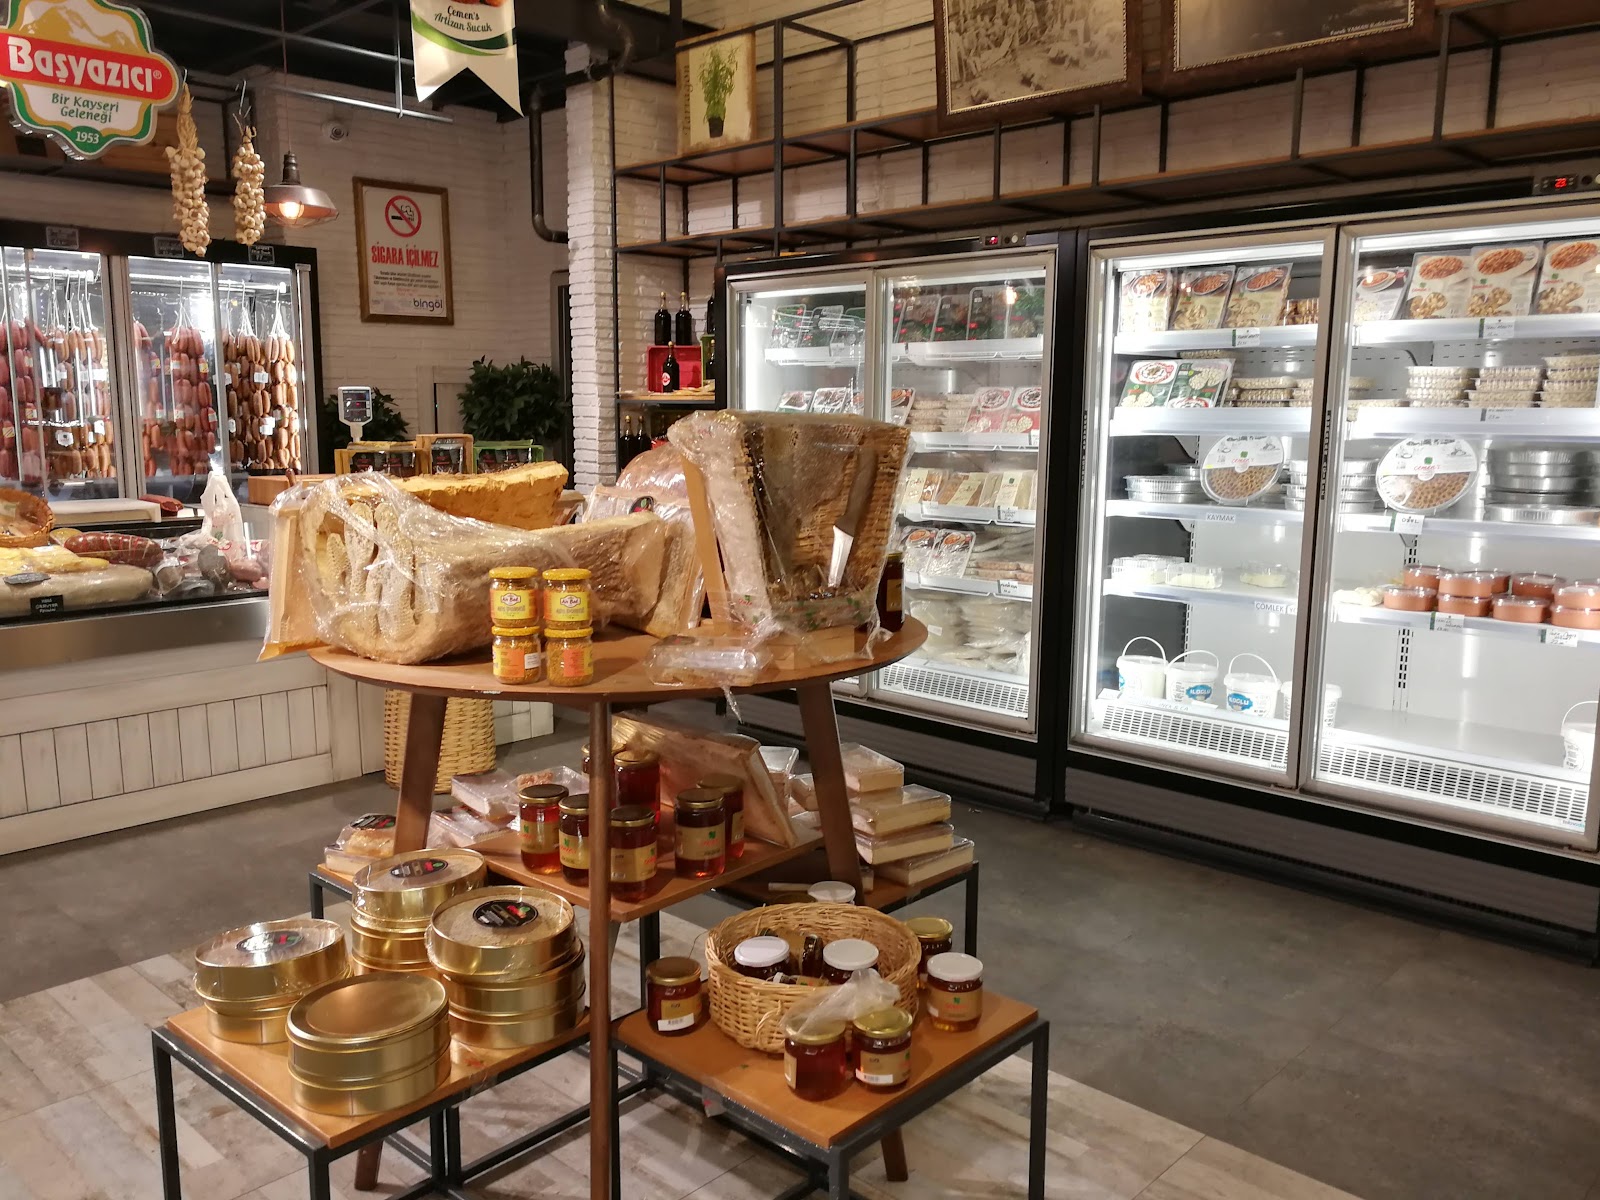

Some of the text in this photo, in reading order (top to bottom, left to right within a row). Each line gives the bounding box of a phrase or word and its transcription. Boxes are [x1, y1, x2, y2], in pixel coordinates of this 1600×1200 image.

[434, 12, 492, 32] Artizan Sucuk
[51, 93, 119, 113] Bir Kayseri
[60, 106, 112, 124] Geleneği
[75, 131, 100, 145] 1953
[371, 241, 439, 269] SİGARA İÇİLMEZ
